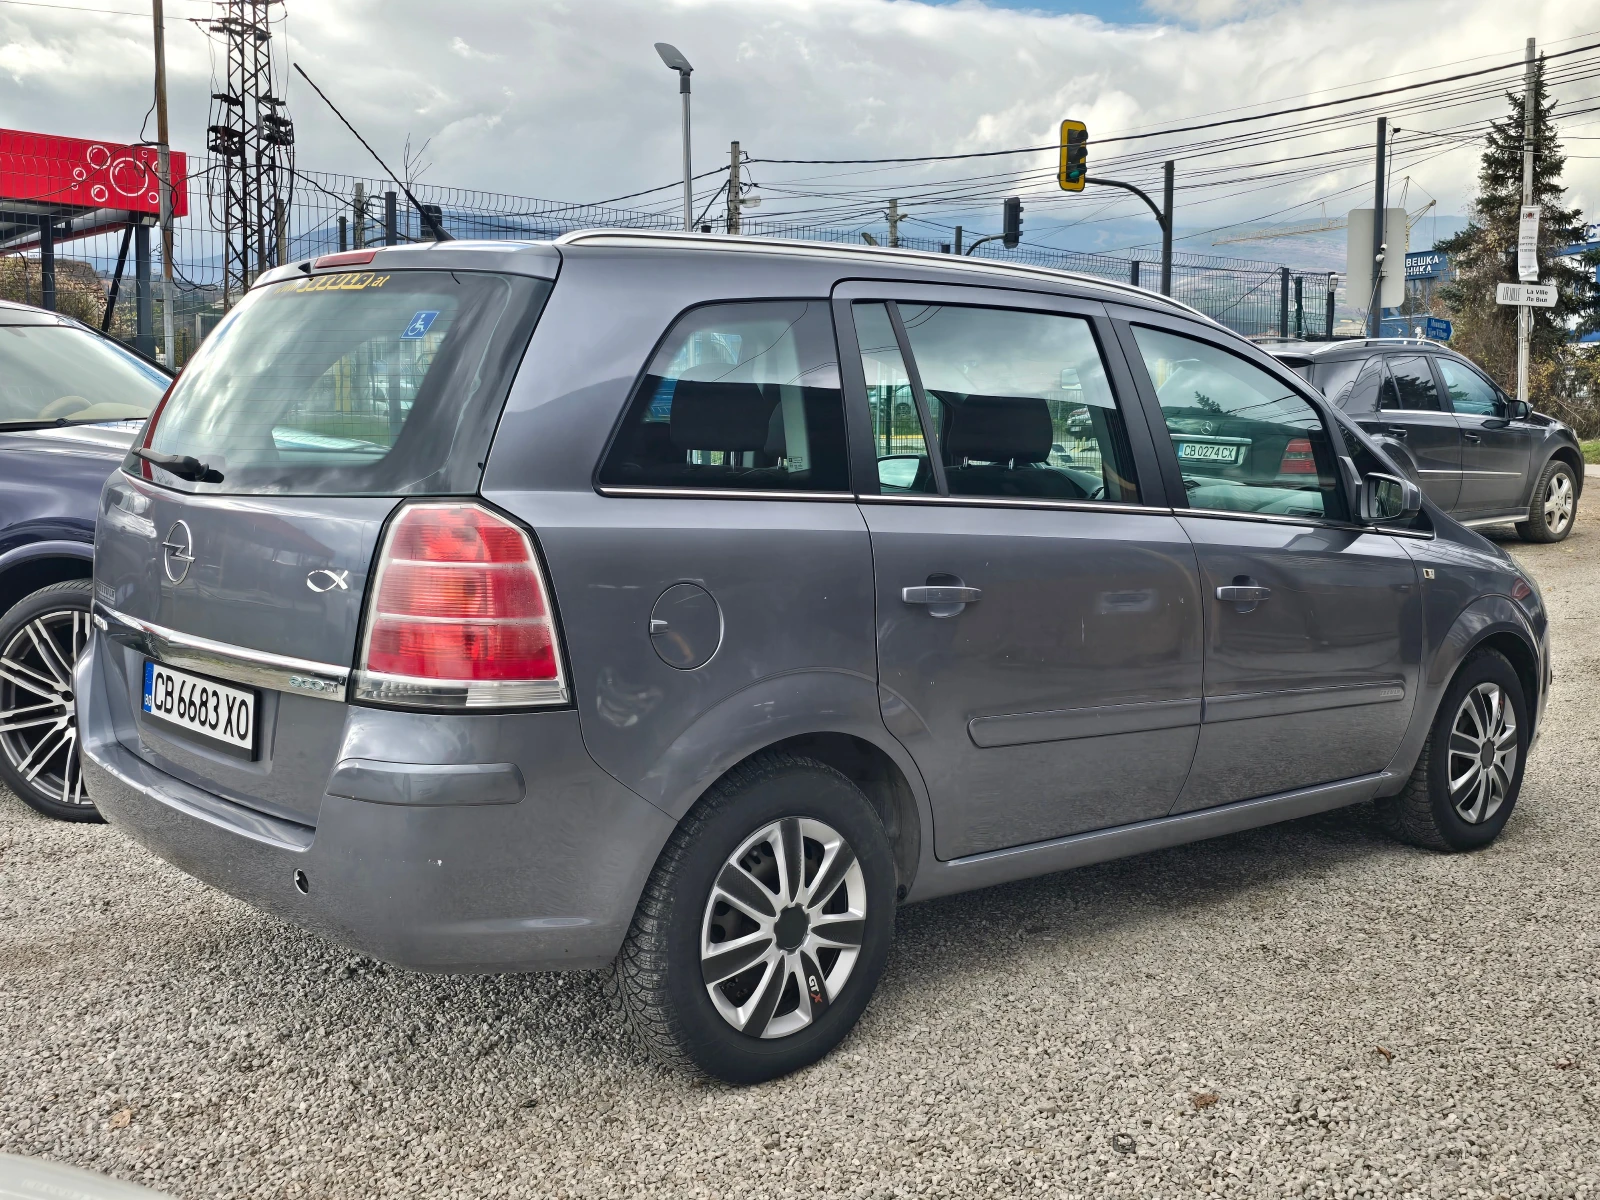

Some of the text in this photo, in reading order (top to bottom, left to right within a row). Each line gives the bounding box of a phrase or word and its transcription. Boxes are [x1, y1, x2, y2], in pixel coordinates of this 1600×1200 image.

[1184, 445, 1234, 459] CB 0274 CX
[154, 671, 249, 741] CB 6683 XO
